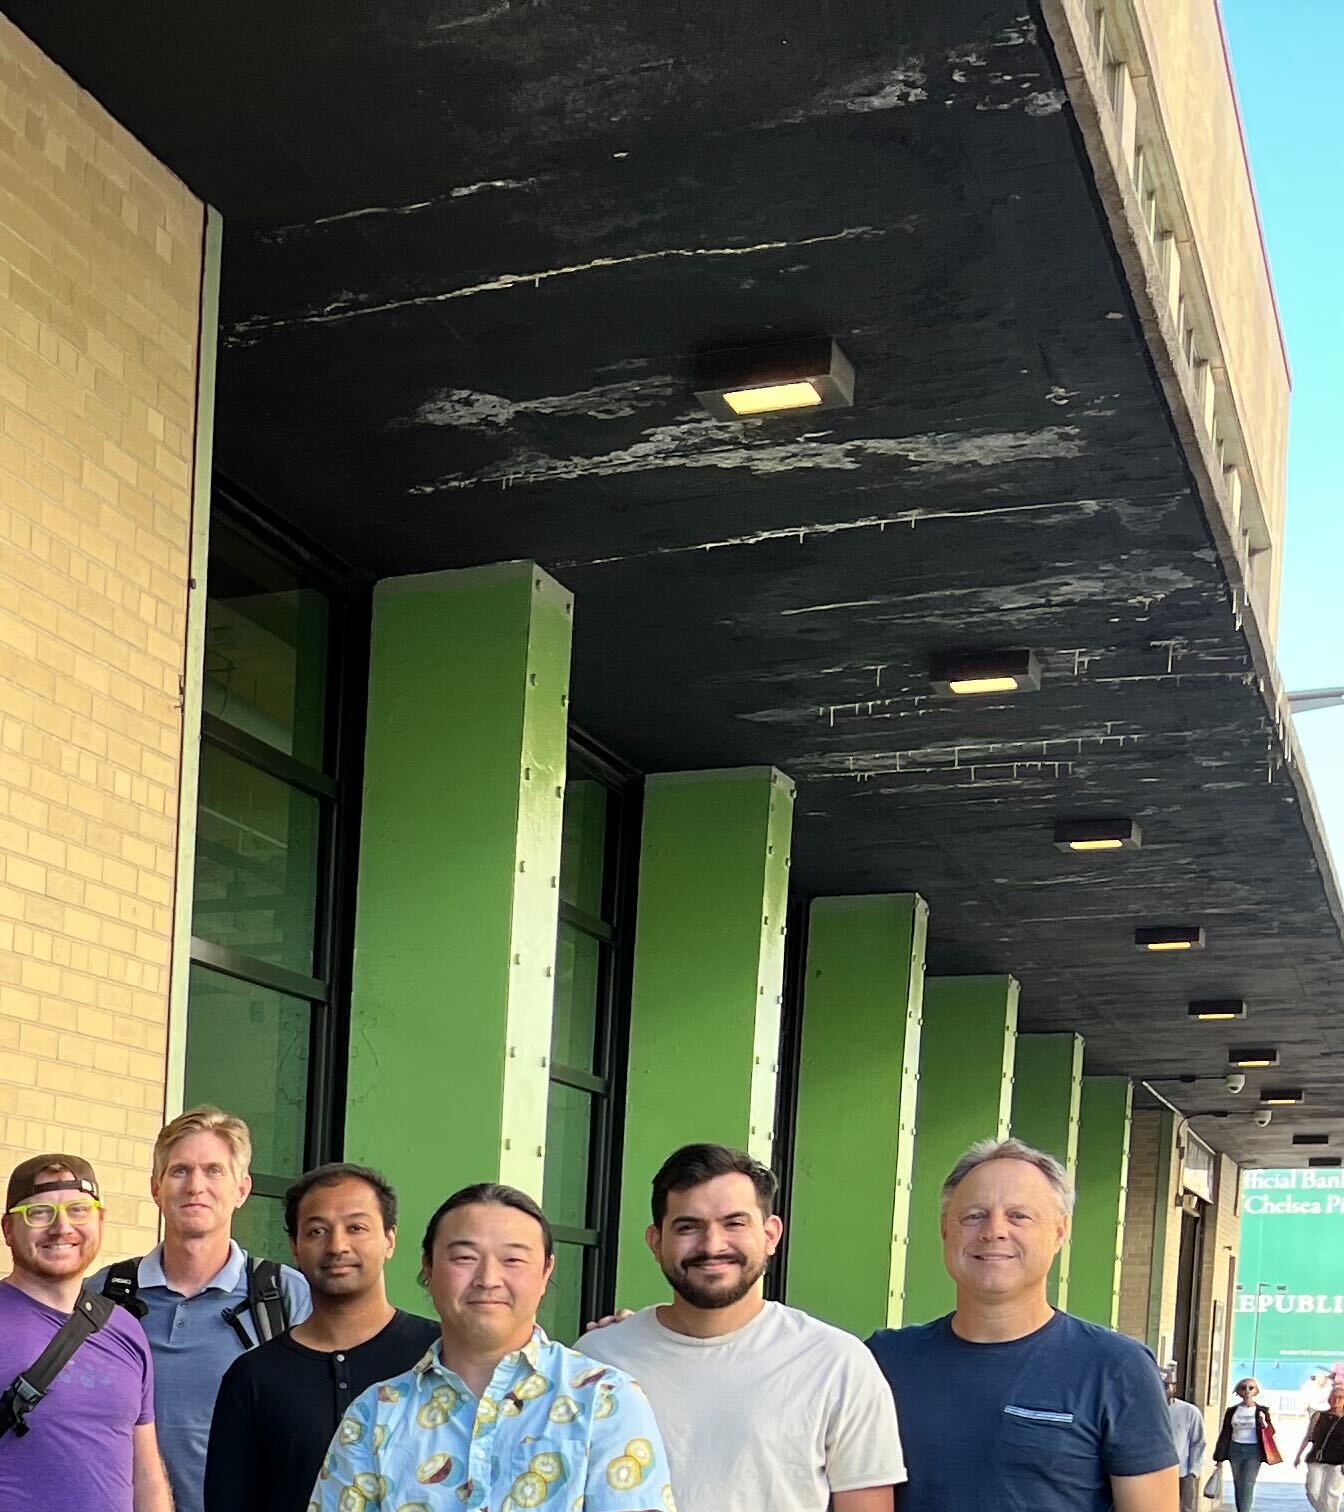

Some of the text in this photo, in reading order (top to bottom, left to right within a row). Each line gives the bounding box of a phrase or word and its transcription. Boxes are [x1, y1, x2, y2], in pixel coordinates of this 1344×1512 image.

[1301, 1168, 1344, 1189] Ban
[1244, 1194, 1321, 1215] Chelsea
[1233, 1294, 1344, 1314] EPUBLI
